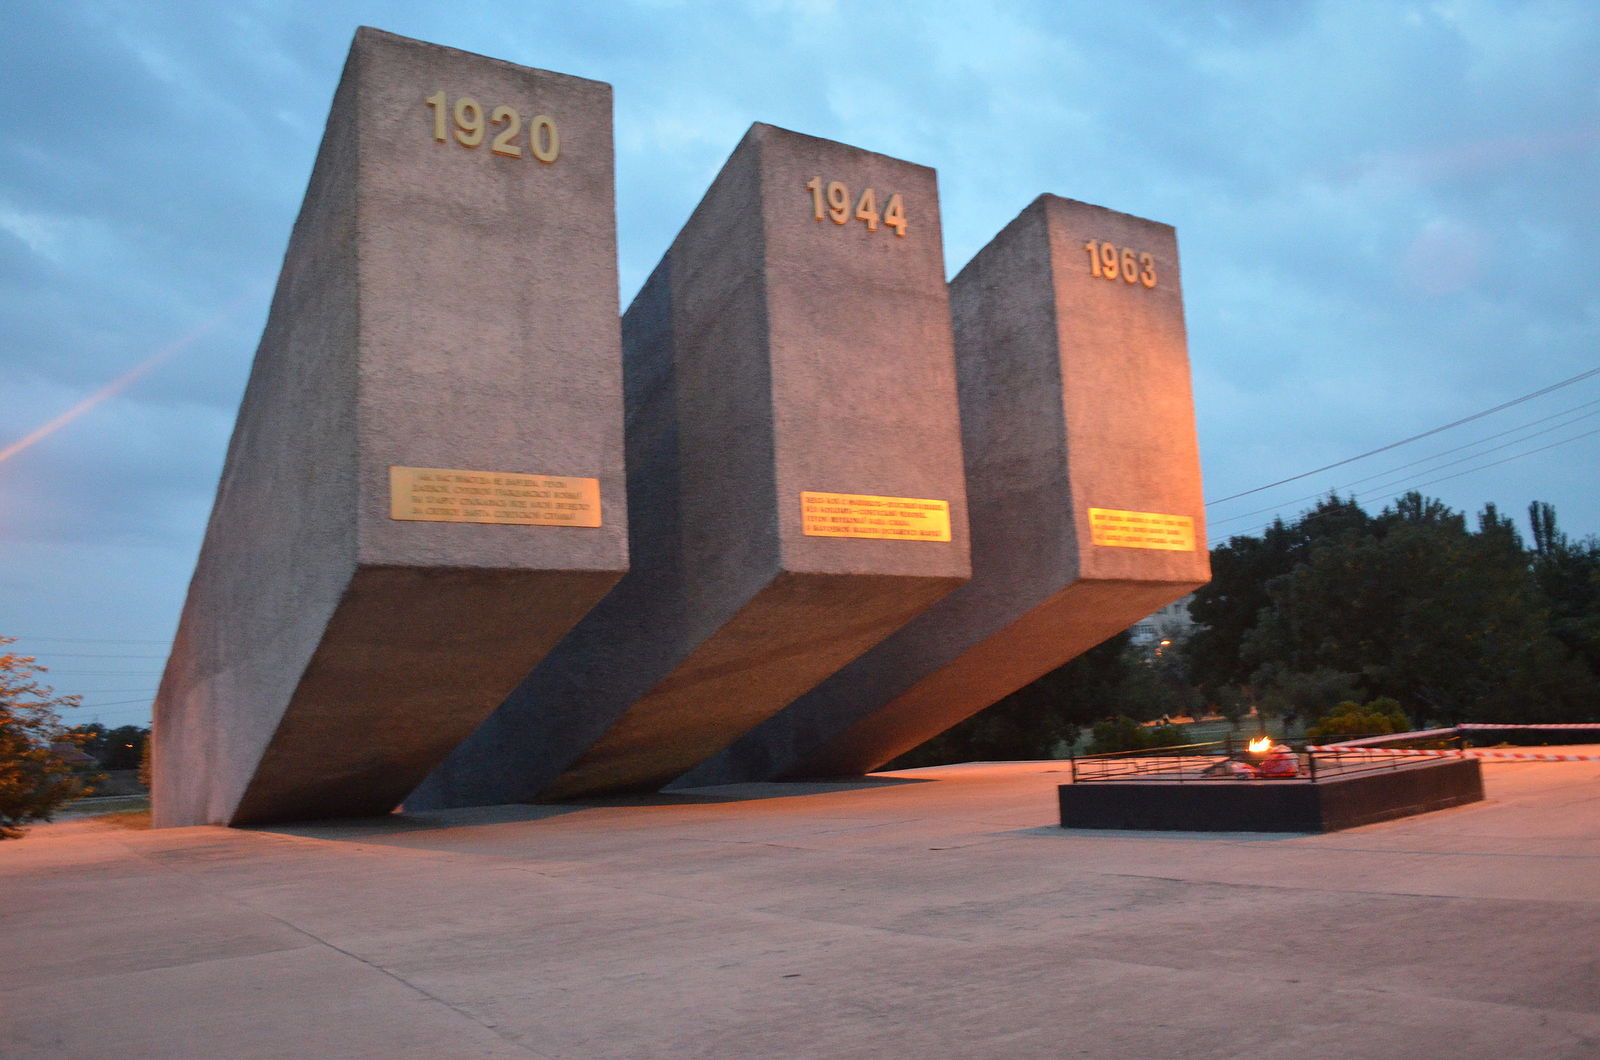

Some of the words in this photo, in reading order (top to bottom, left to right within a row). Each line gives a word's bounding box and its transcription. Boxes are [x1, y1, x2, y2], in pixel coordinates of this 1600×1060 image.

[425, 90, 560, 164] 1920
[806, 176, 908, 238] 1944
[1083, 239, 1157, 288] 1963
